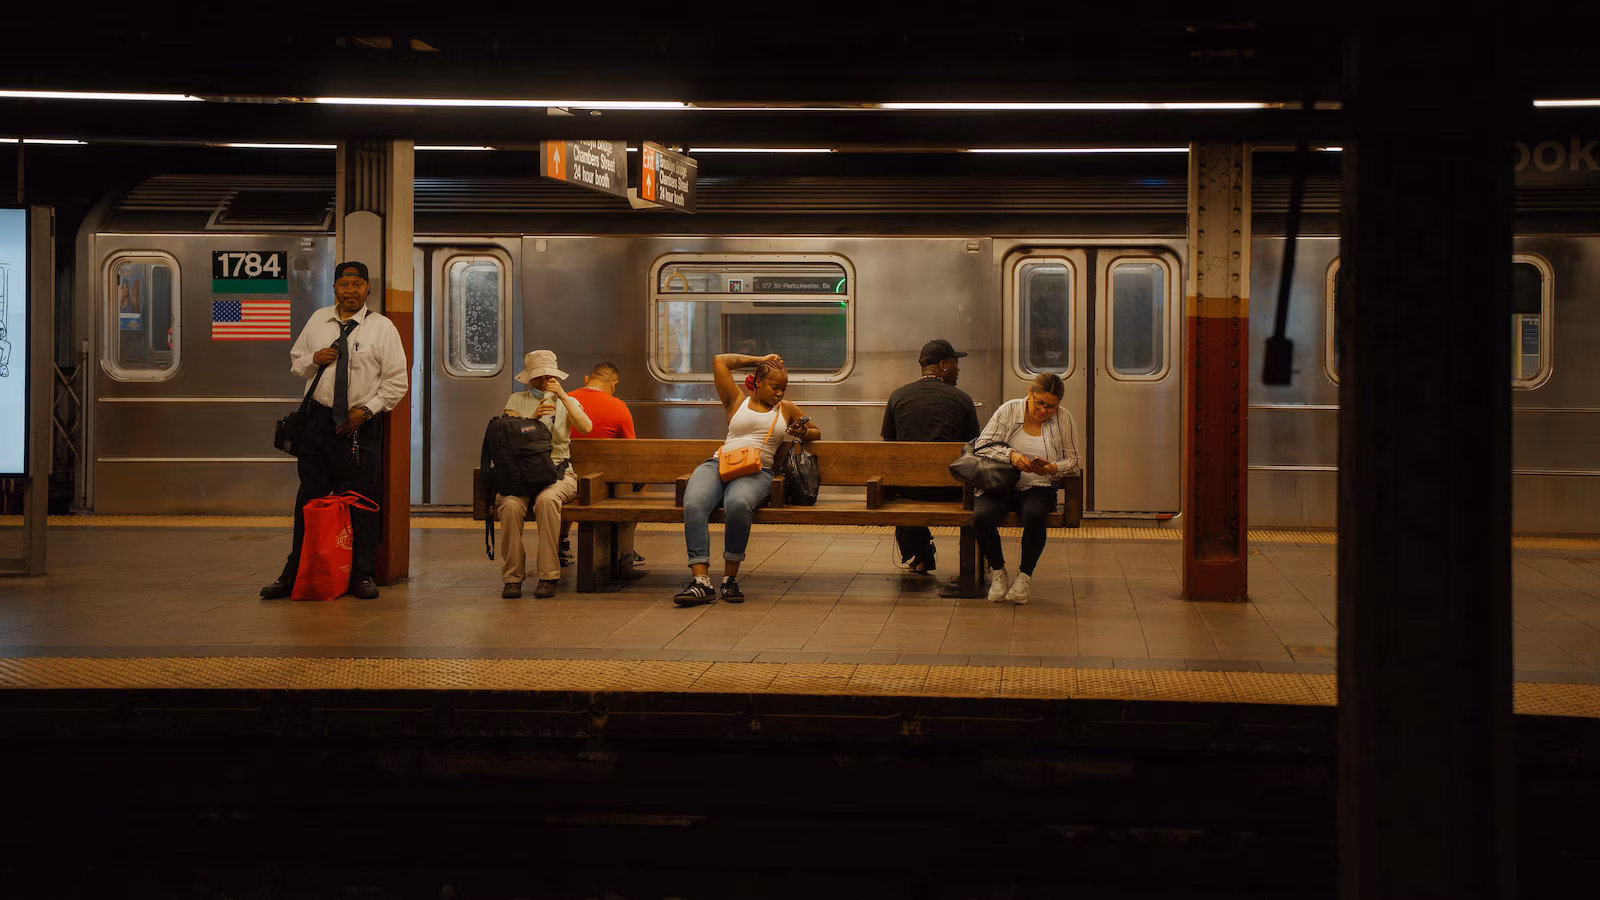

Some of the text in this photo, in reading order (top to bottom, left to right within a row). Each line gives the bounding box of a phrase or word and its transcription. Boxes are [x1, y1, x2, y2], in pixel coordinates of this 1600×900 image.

[573, 144, 600, 168] Chambers
[600, 153, 615, 173] Street
[643, 147, 654, 170] Exit
[573, 163, 609, 189] 24 hour booth
[659, 170, 689, 193] Chambers Street
[660, 186, 685, 206] 24 hour booth
[218, 253, 281, 277] 1784
